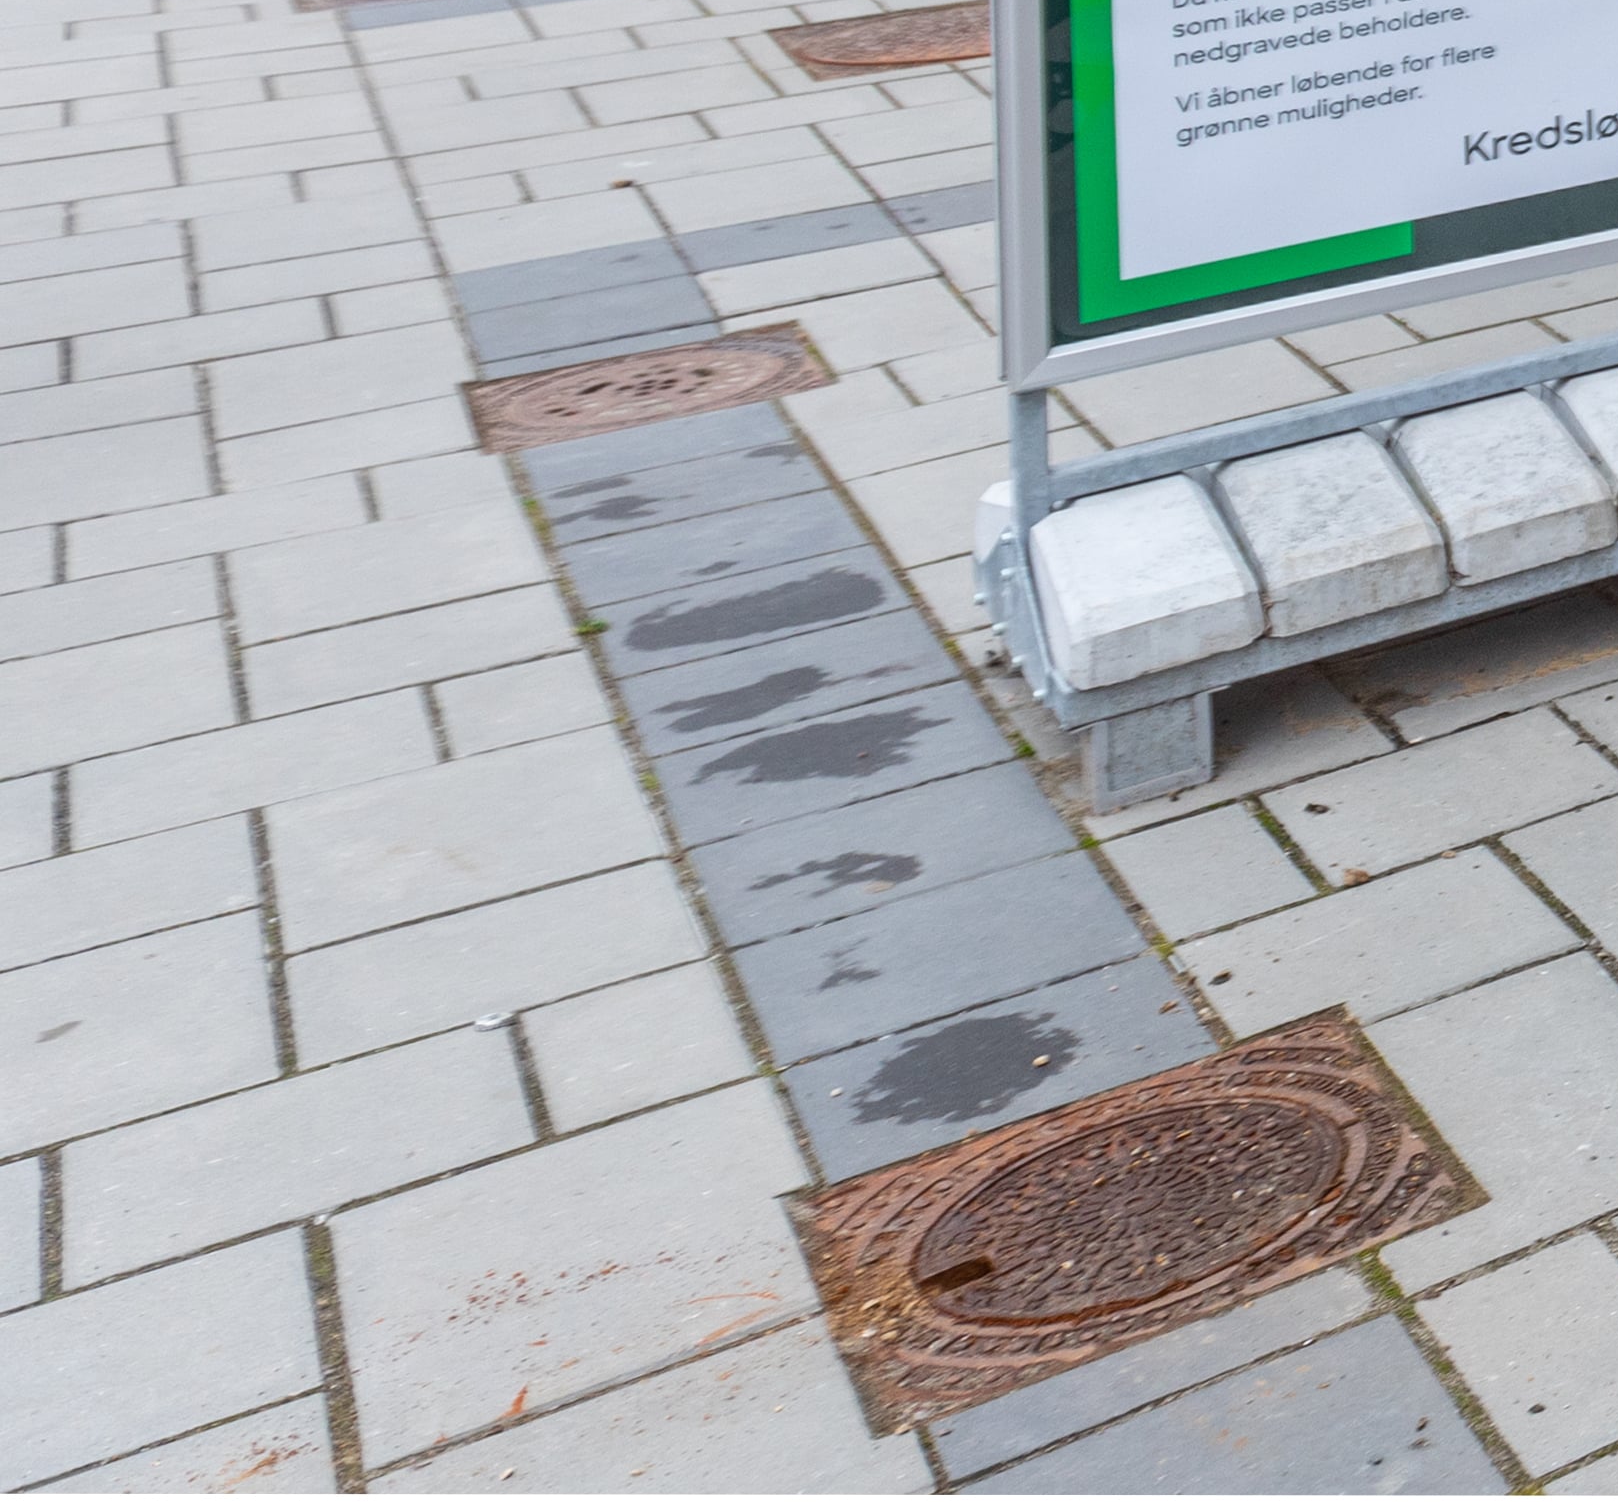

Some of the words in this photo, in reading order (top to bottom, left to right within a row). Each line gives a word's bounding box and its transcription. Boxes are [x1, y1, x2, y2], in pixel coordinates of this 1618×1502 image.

[1172, 17, 1228, 38] som
[1234, 7, 1286, 30] ikke
[1174, 25, 1332, 68] nedgravede
[1339, 4, 1471, 42] beholdere.
[1174, 91, 1201, 114] Vi
[1206, 78, 1285, 109] åbner
[1290, 58, 1395, 94] løbende
[1401, 51, 1434, 75] for
[1441, 42, 1497, 67] flere
[1175, 111, 1270, 148] grønne
[1277, 82, 1424, 125] muligheder.
